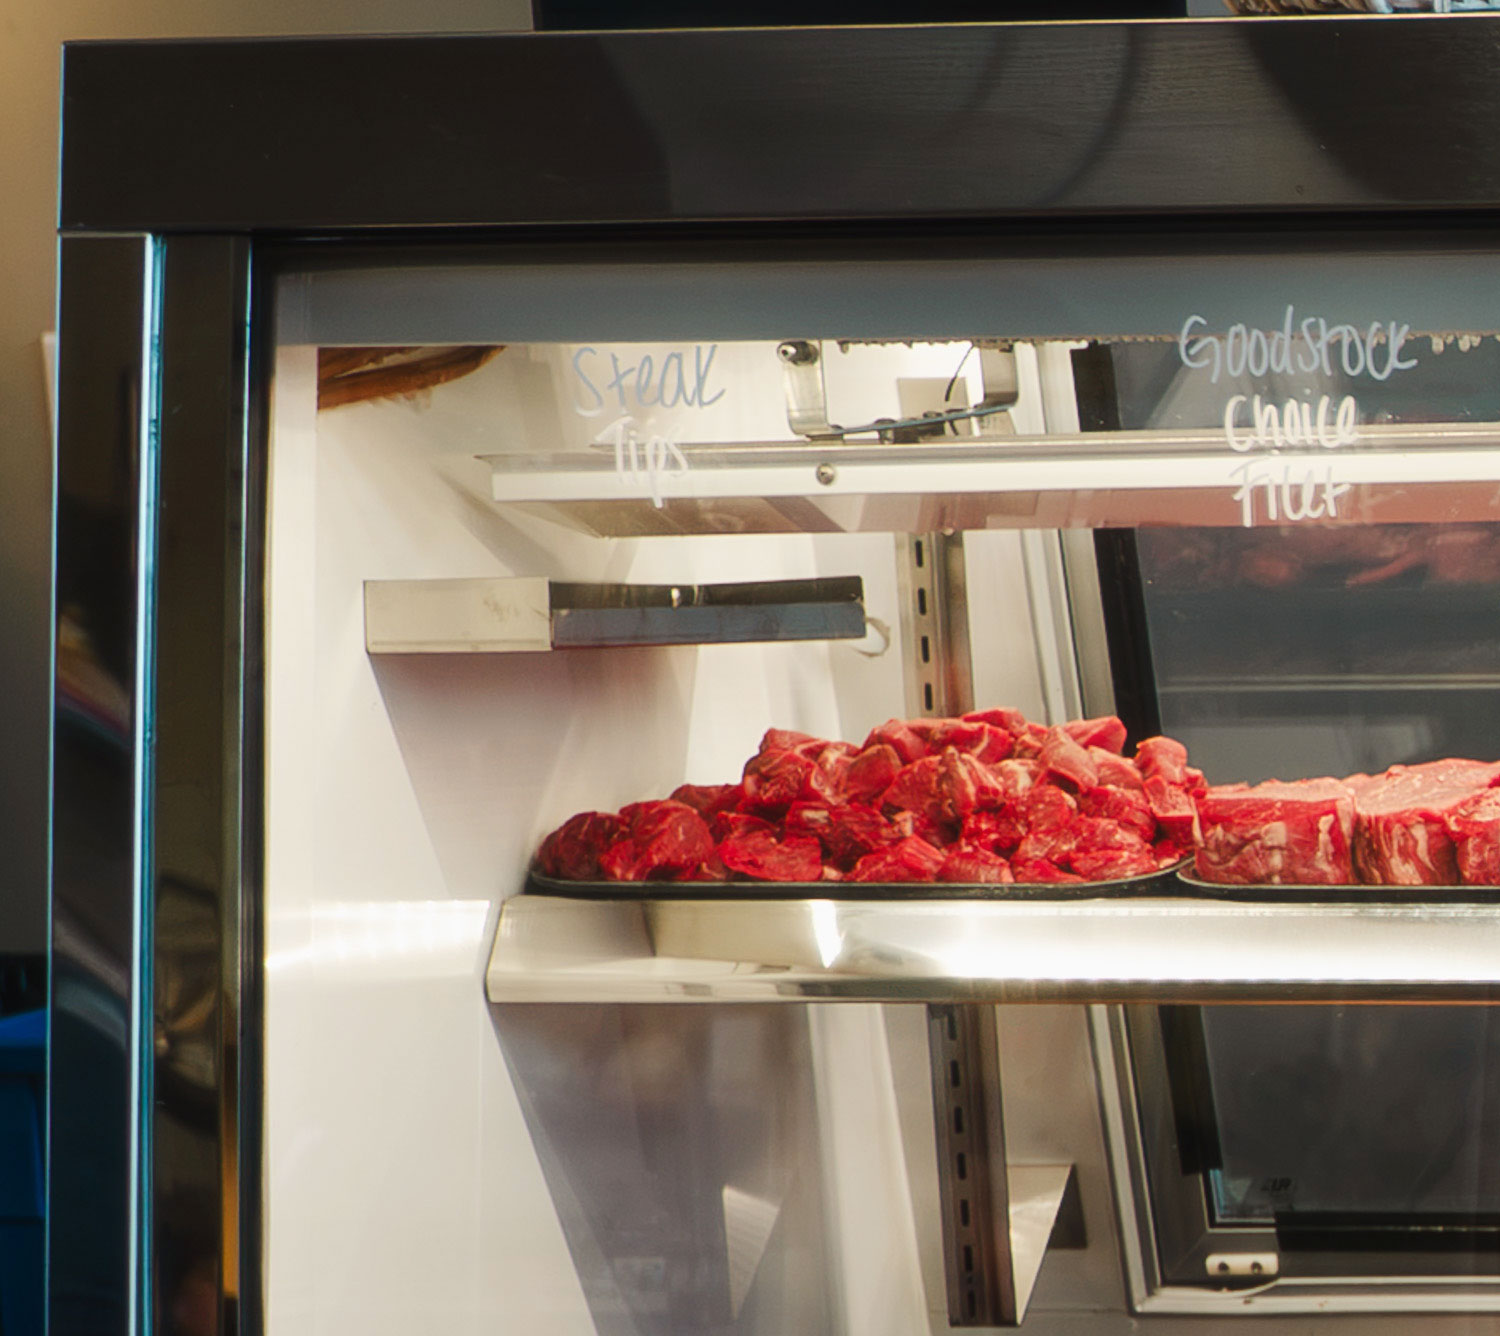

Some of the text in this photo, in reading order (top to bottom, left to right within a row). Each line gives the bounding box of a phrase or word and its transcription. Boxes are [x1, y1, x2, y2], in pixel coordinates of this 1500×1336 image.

[571, 343, 728, 420] Steak
[1179, 304, 1419, 387] Goodstock
[603, 416, 691, 510] Tips
